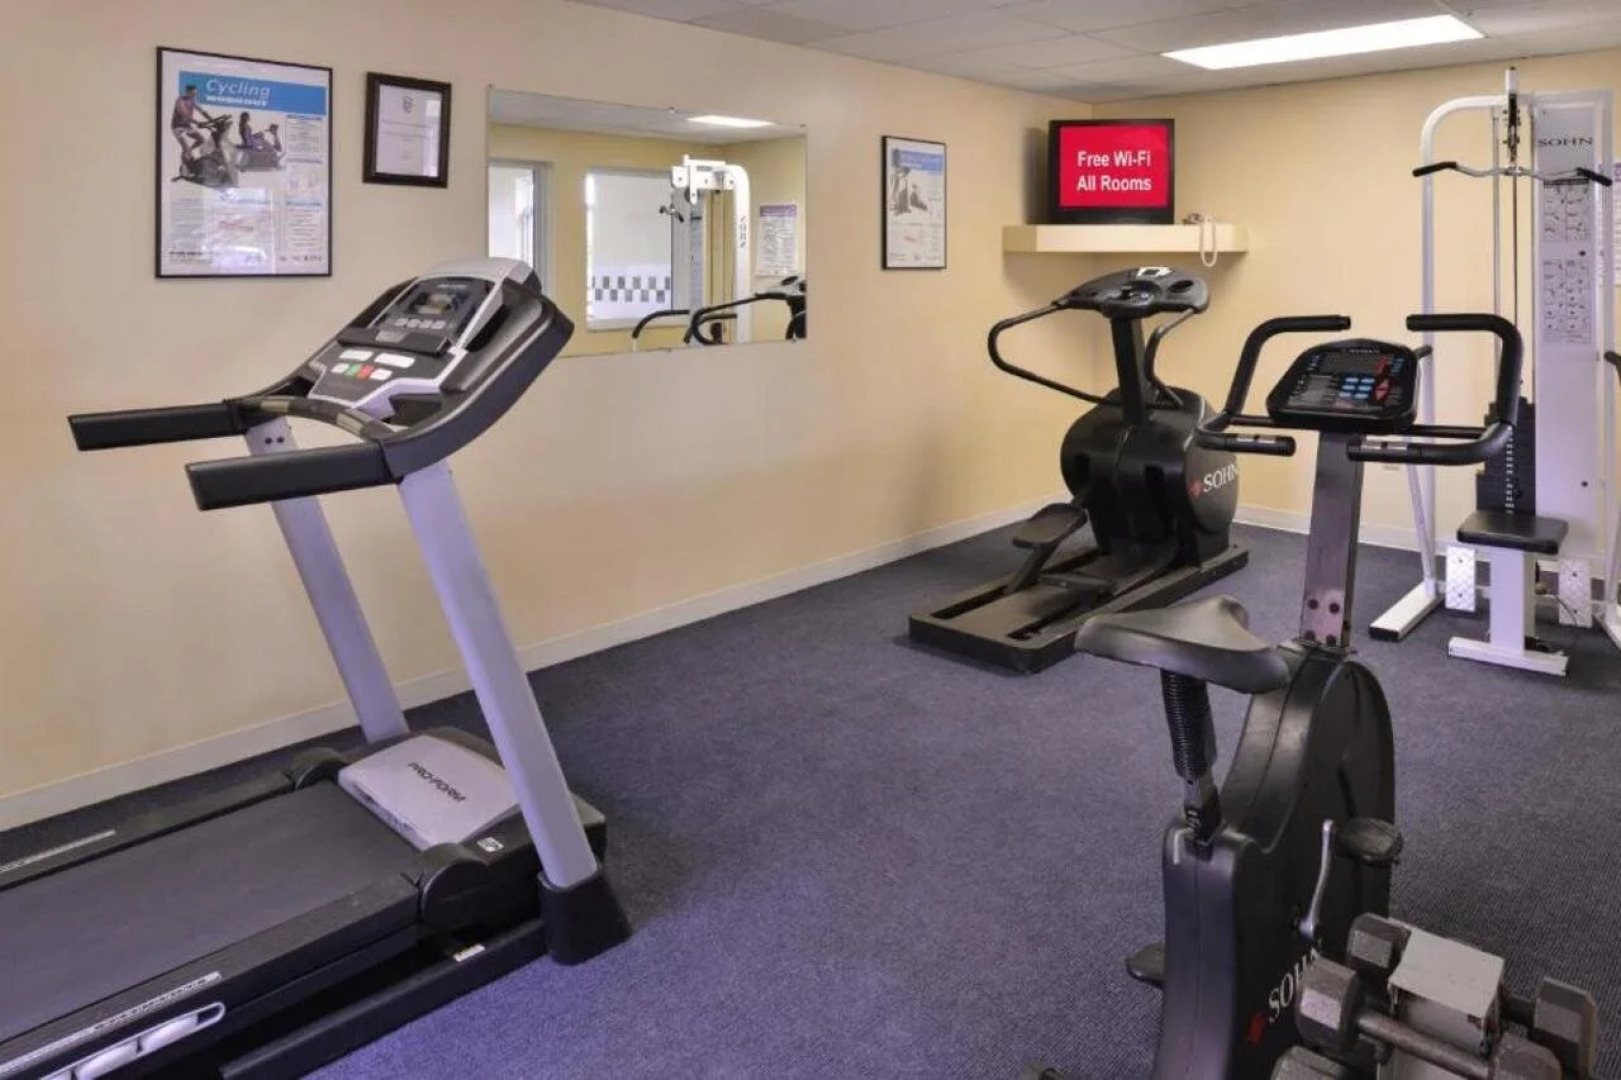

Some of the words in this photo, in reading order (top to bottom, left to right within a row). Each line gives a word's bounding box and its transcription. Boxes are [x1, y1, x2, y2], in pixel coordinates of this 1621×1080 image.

[206, 79, 271, 98] Cycling
[1538, 137, 1593, 147] SOHN
[1077, 151, 1110, 167] Free
[1114, 151, 1151, 167] Wi-Fi
[1077, 175, 1096, 191] All
[1101, 175, 1152, 191] Rooms
